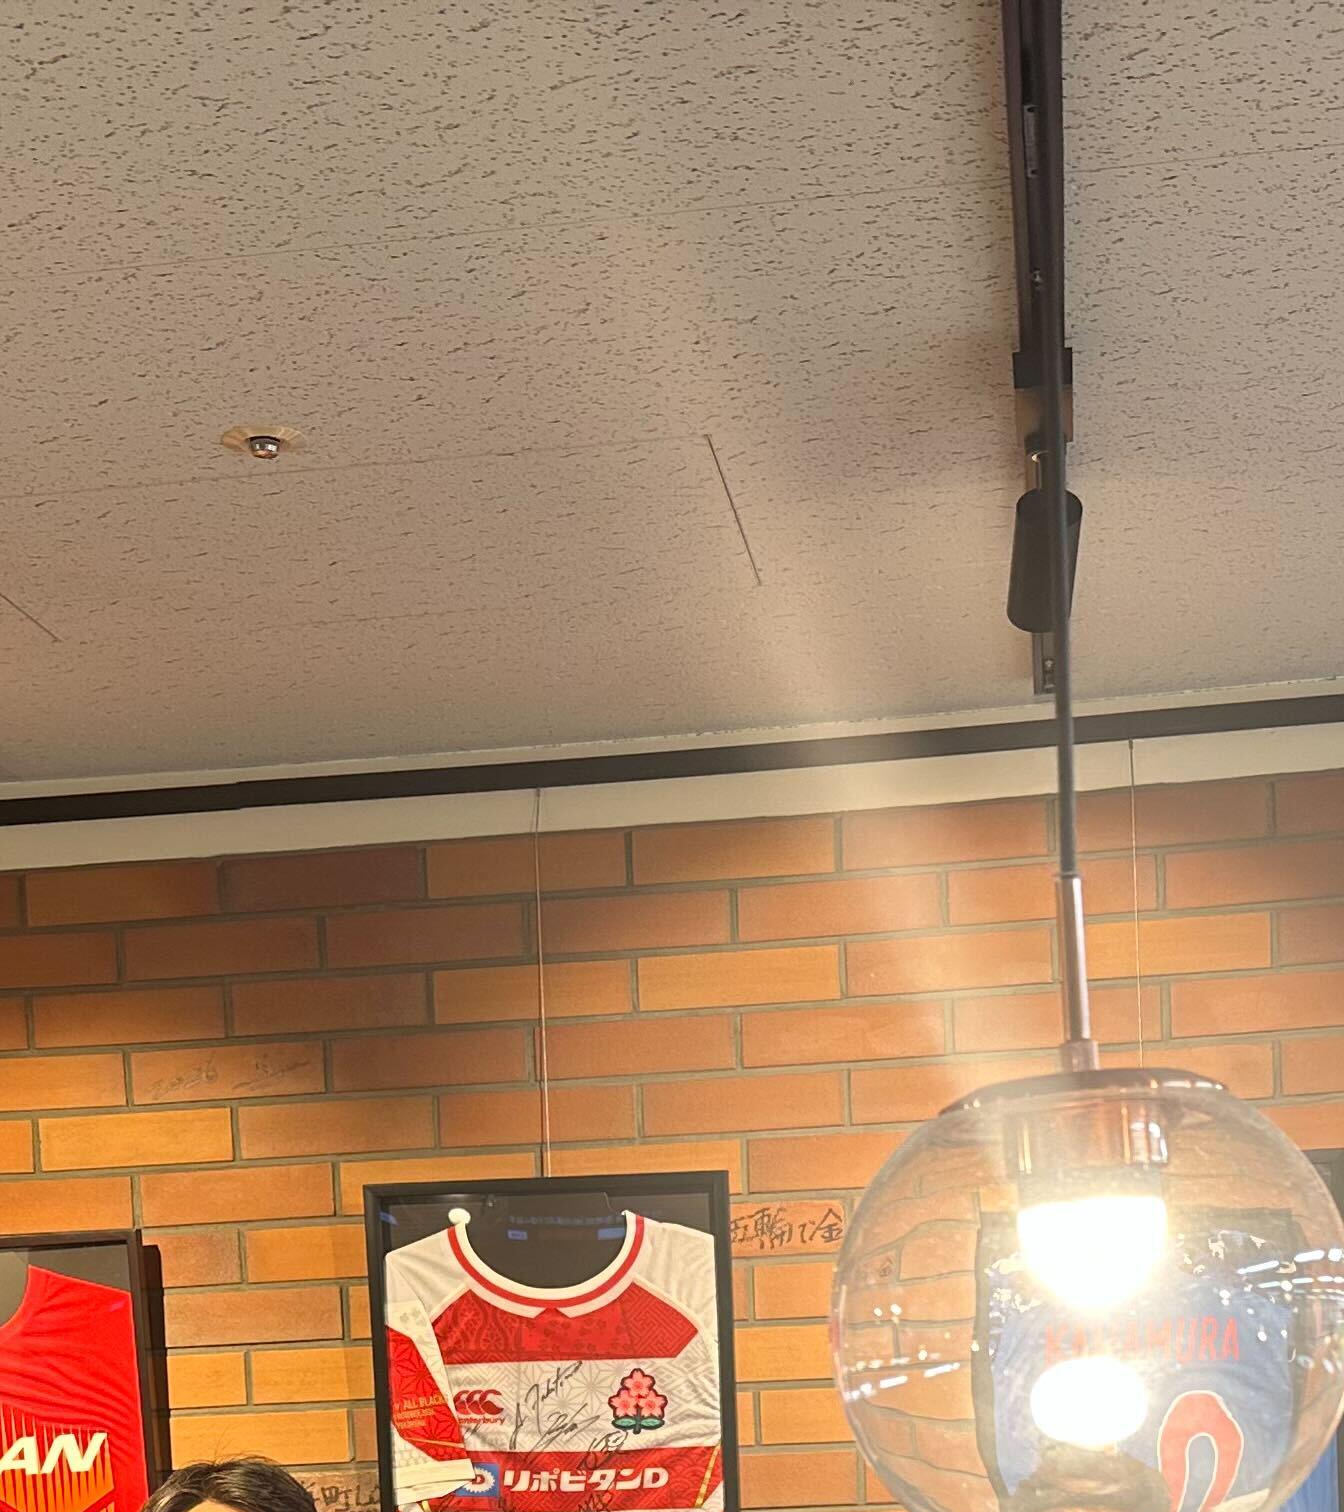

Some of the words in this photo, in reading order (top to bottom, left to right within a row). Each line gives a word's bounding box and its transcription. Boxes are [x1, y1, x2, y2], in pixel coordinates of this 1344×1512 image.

[503, 1466, 669, 1493] リポビタンD
